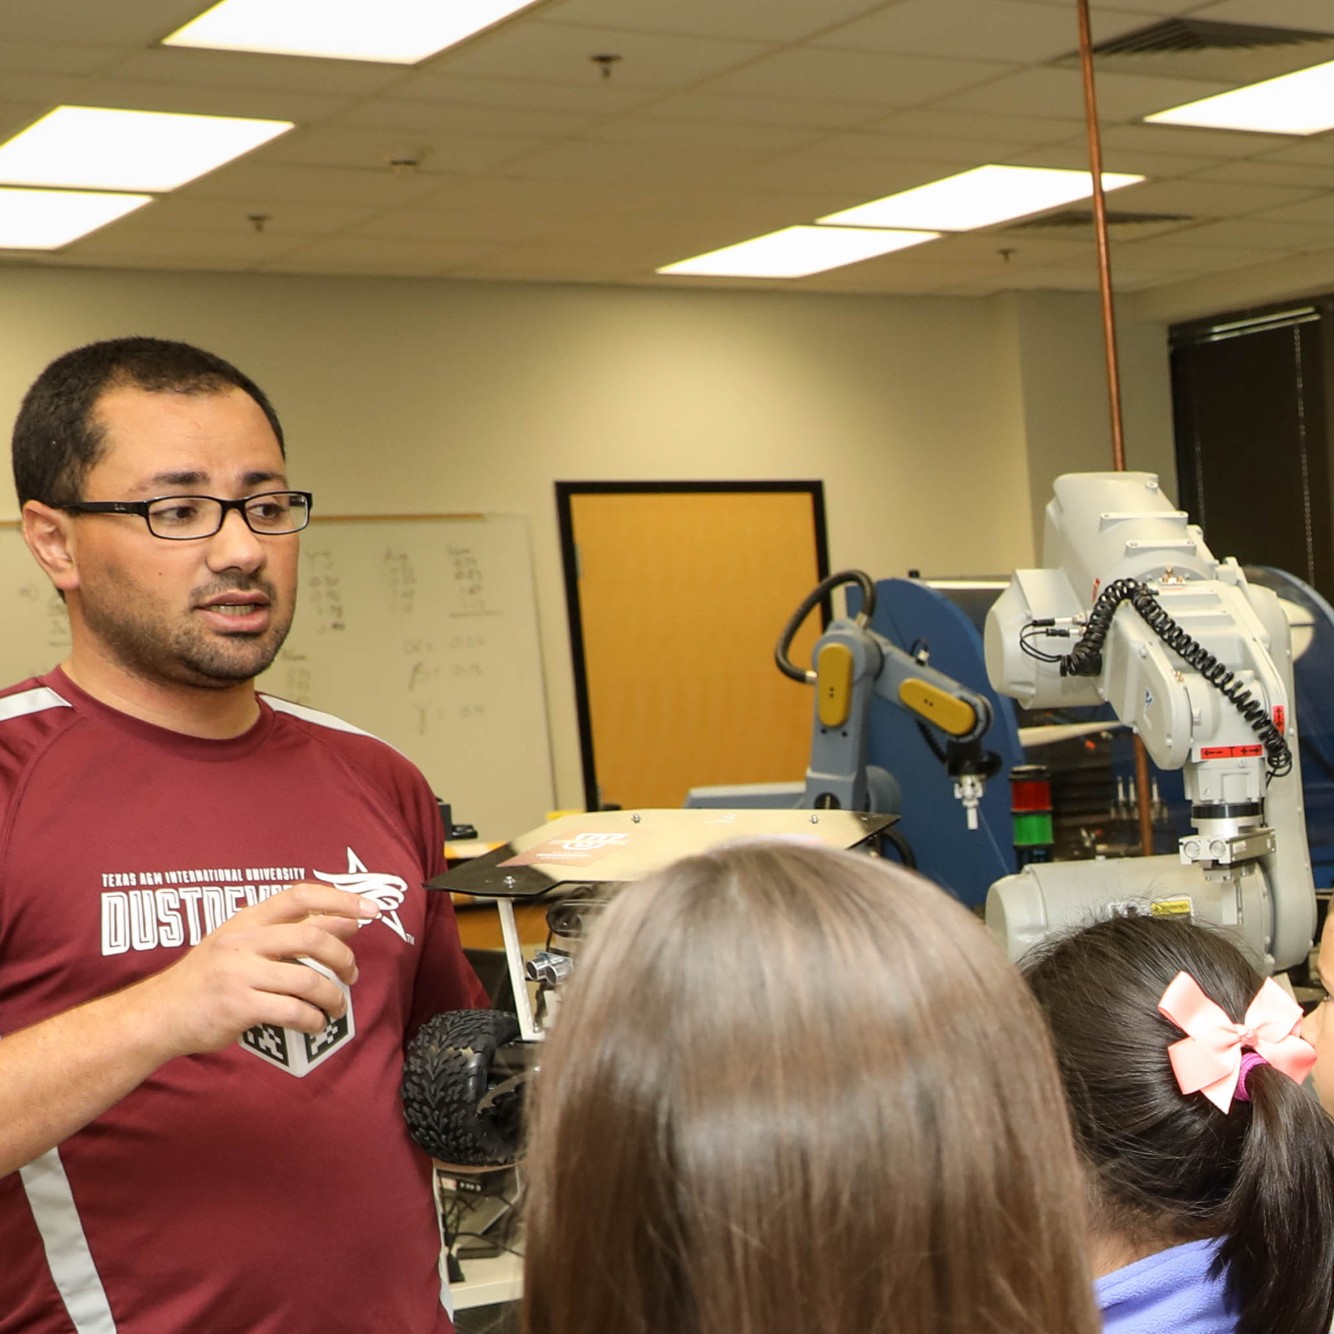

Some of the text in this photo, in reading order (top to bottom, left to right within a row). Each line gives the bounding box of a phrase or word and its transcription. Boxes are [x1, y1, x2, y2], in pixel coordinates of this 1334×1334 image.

[102, 872, 137, 888] TEXAS
[165, 868, 244, 884] INTERNATIONAL
[245, 867, 305, 881] UNIVERSITY
